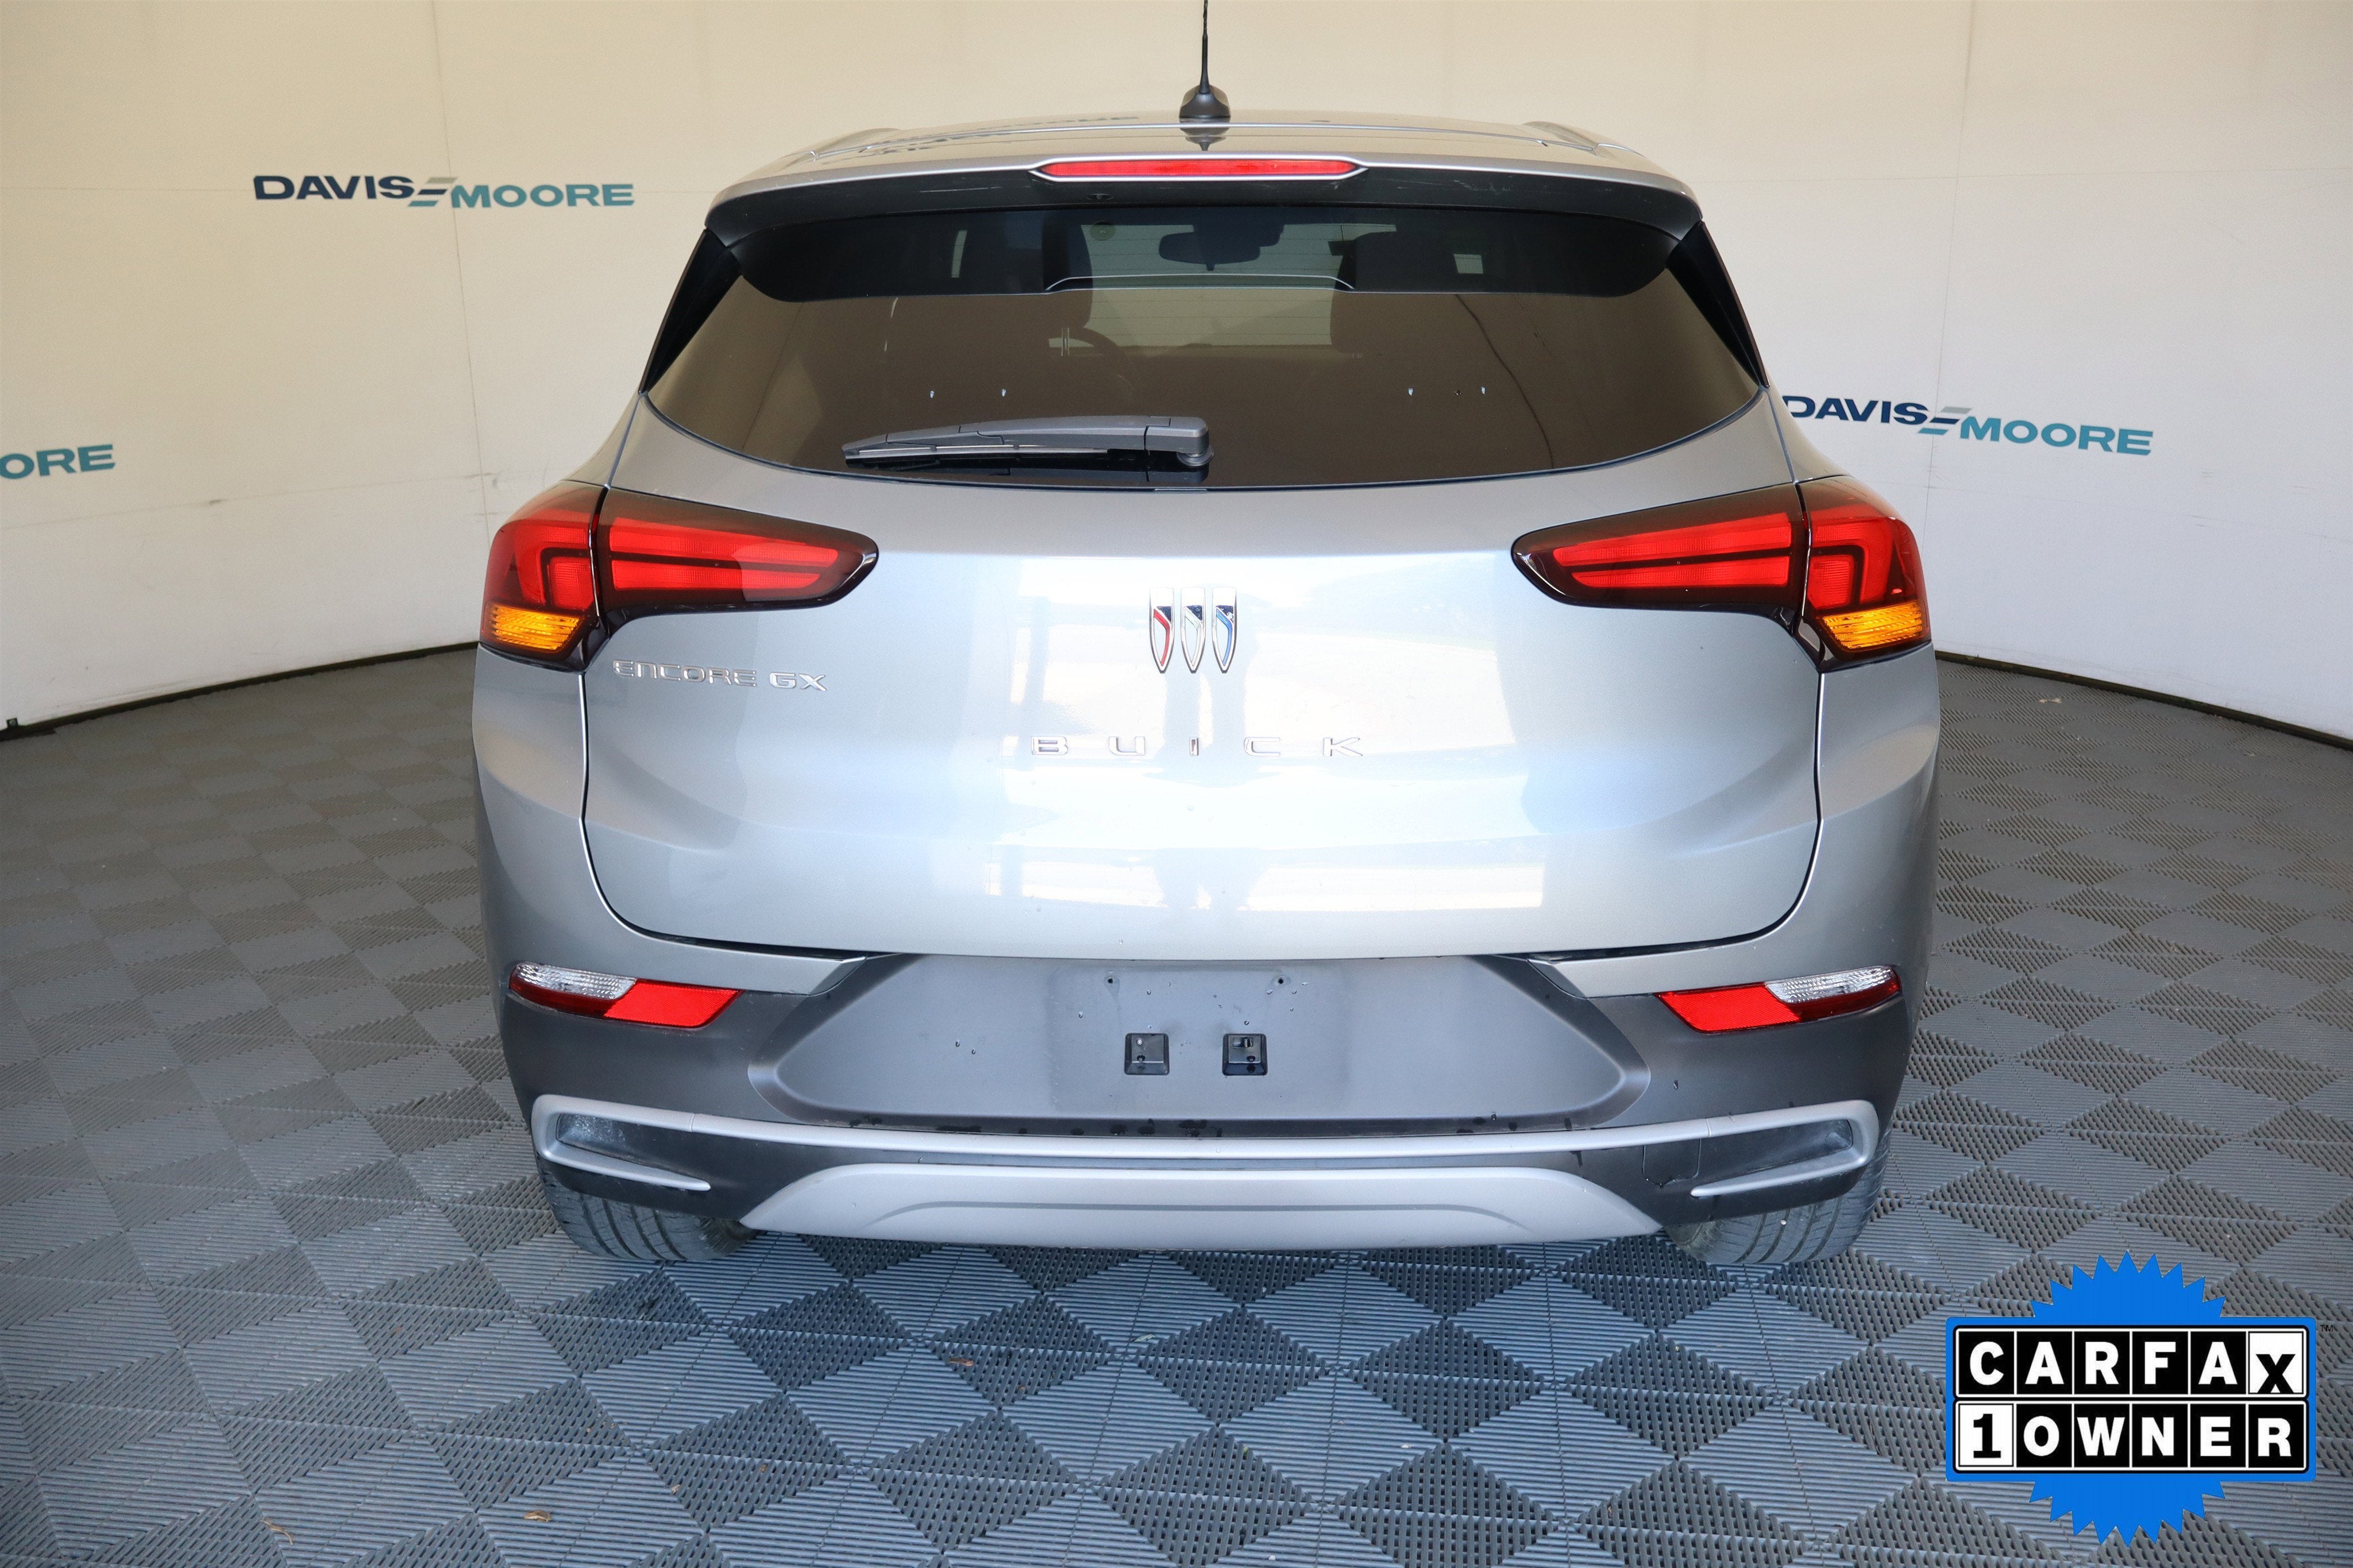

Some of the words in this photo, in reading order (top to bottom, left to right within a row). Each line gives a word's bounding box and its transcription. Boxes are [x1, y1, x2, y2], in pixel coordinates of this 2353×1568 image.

[253, 176, 414, 200] DAVIS
[450, 183, 635, 208] MOORE
[1782, 395, 1928, 425] DAVIS
[1959, 416, 2154, 456] MOORE
[612, 659, 757, 687] ENCORE
[769, 671, 827, 692] GX
[1031, 736, 1363, 757] BUICK
